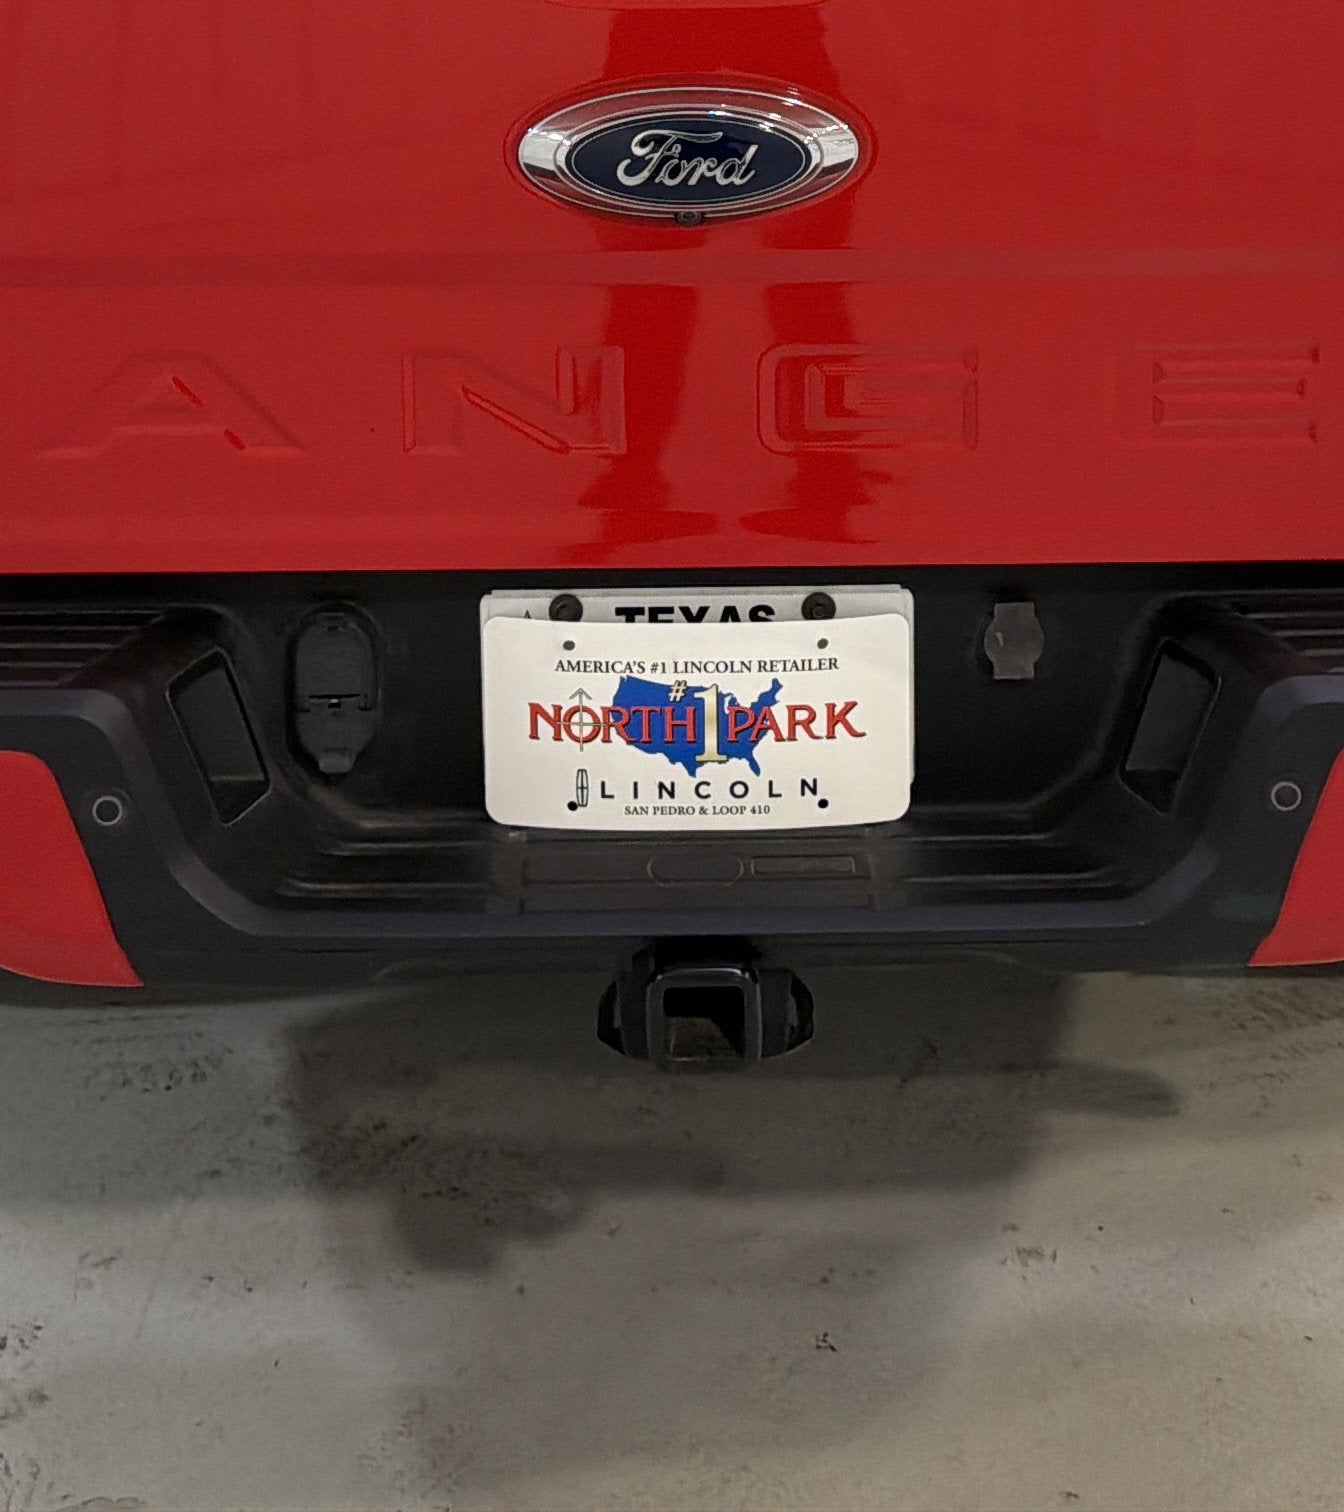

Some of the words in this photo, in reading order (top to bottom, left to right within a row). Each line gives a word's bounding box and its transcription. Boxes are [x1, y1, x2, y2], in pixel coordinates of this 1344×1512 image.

[616, 129, 758, 186] Ford
[554, 659, 646, 674] AMERICA'S
[650, 661, 667, 674] #1
[673, 660, 753, 674] LINCOLN
[757, 657, 840, 673] RETAILER
[528, 702, 697, 744] NORTH
[727, 701, 866, 743] PARK
[600, 778, 817, 800] LINCOLN
[624, 805, 649, 816] SAN
[652, 805, 696, 816] PEDRO
[698, 806, 709, 816] &
[712, 805, 747, 816] LOOP
[749, 804, 771, 815] 410
